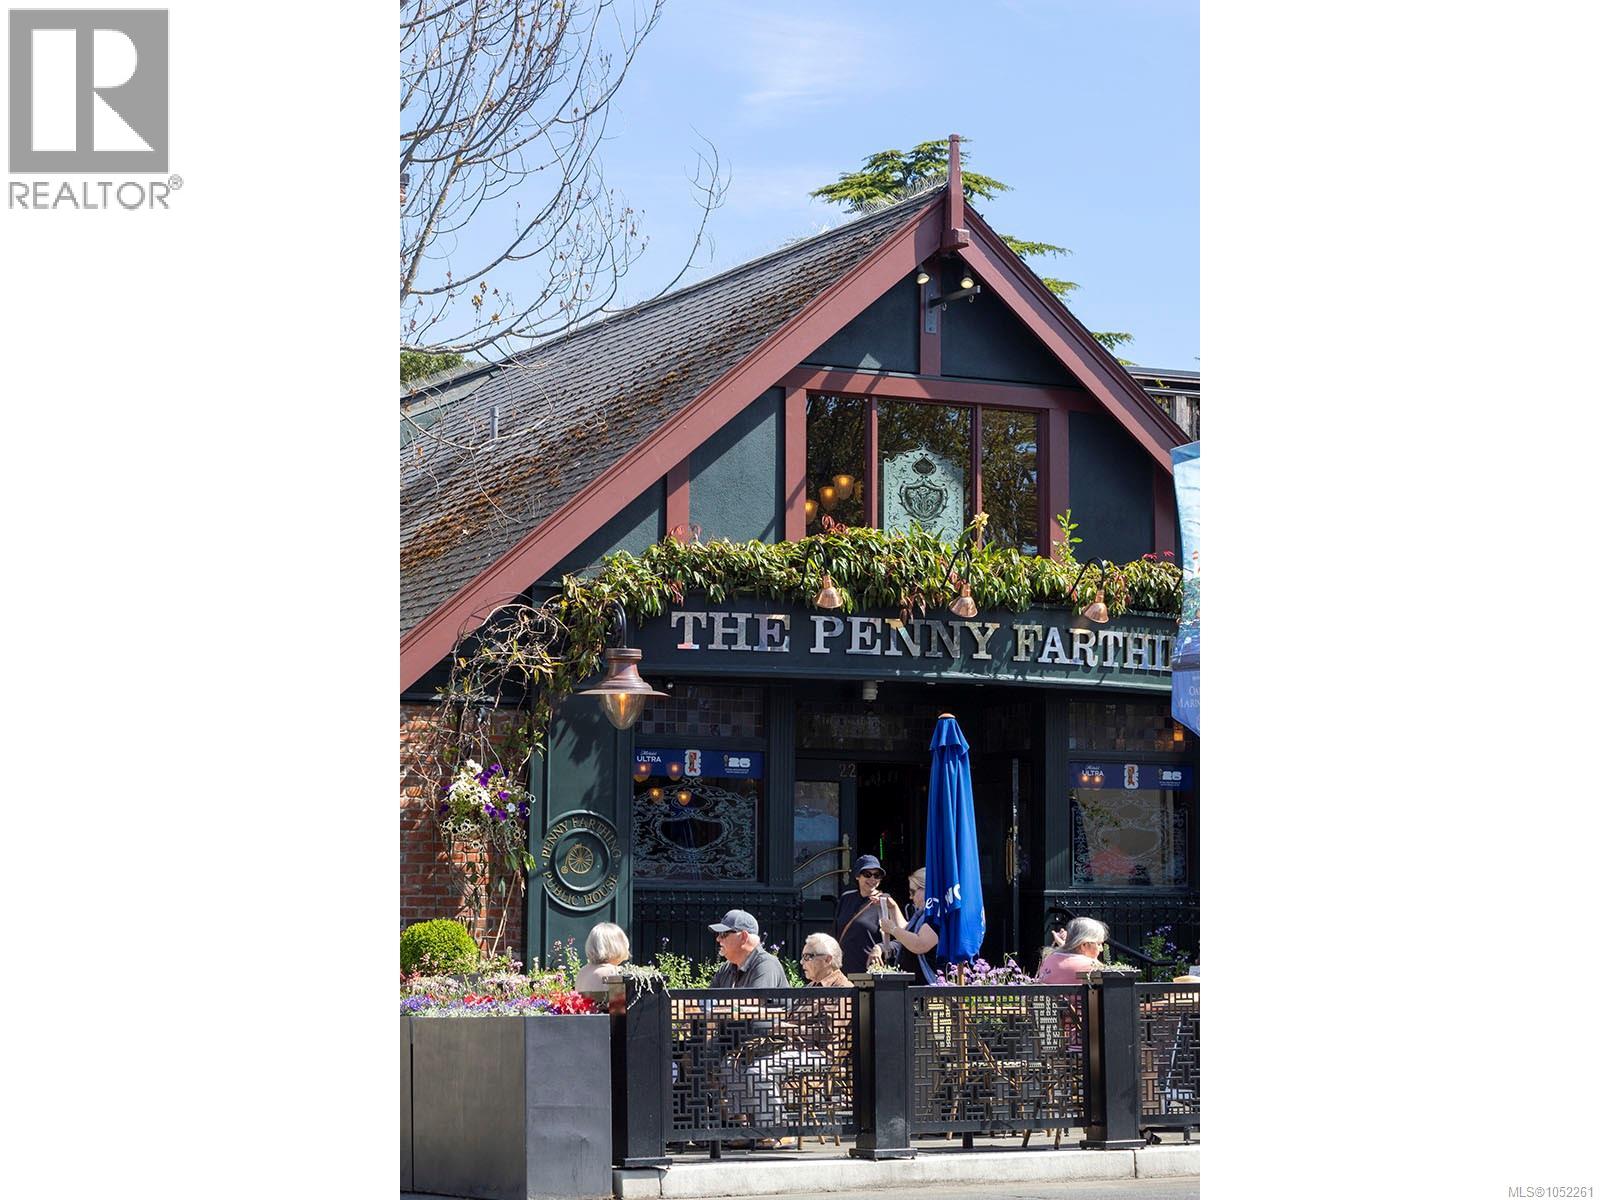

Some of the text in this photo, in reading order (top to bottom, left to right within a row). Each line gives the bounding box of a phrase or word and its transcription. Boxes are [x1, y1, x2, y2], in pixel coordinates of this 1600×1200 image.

[671, 611, 790, 652] THE
[810, 615, 1001, 660] PENNY
[636, 755, 662, 763] ULTRA
[728, 757, 751, 768] 26
[839, 763, 857, 778] 22
[541, 816, 622, 859] PENNY FARTHING
[543, 870, 618, 906] PUBLIC HOUSE
